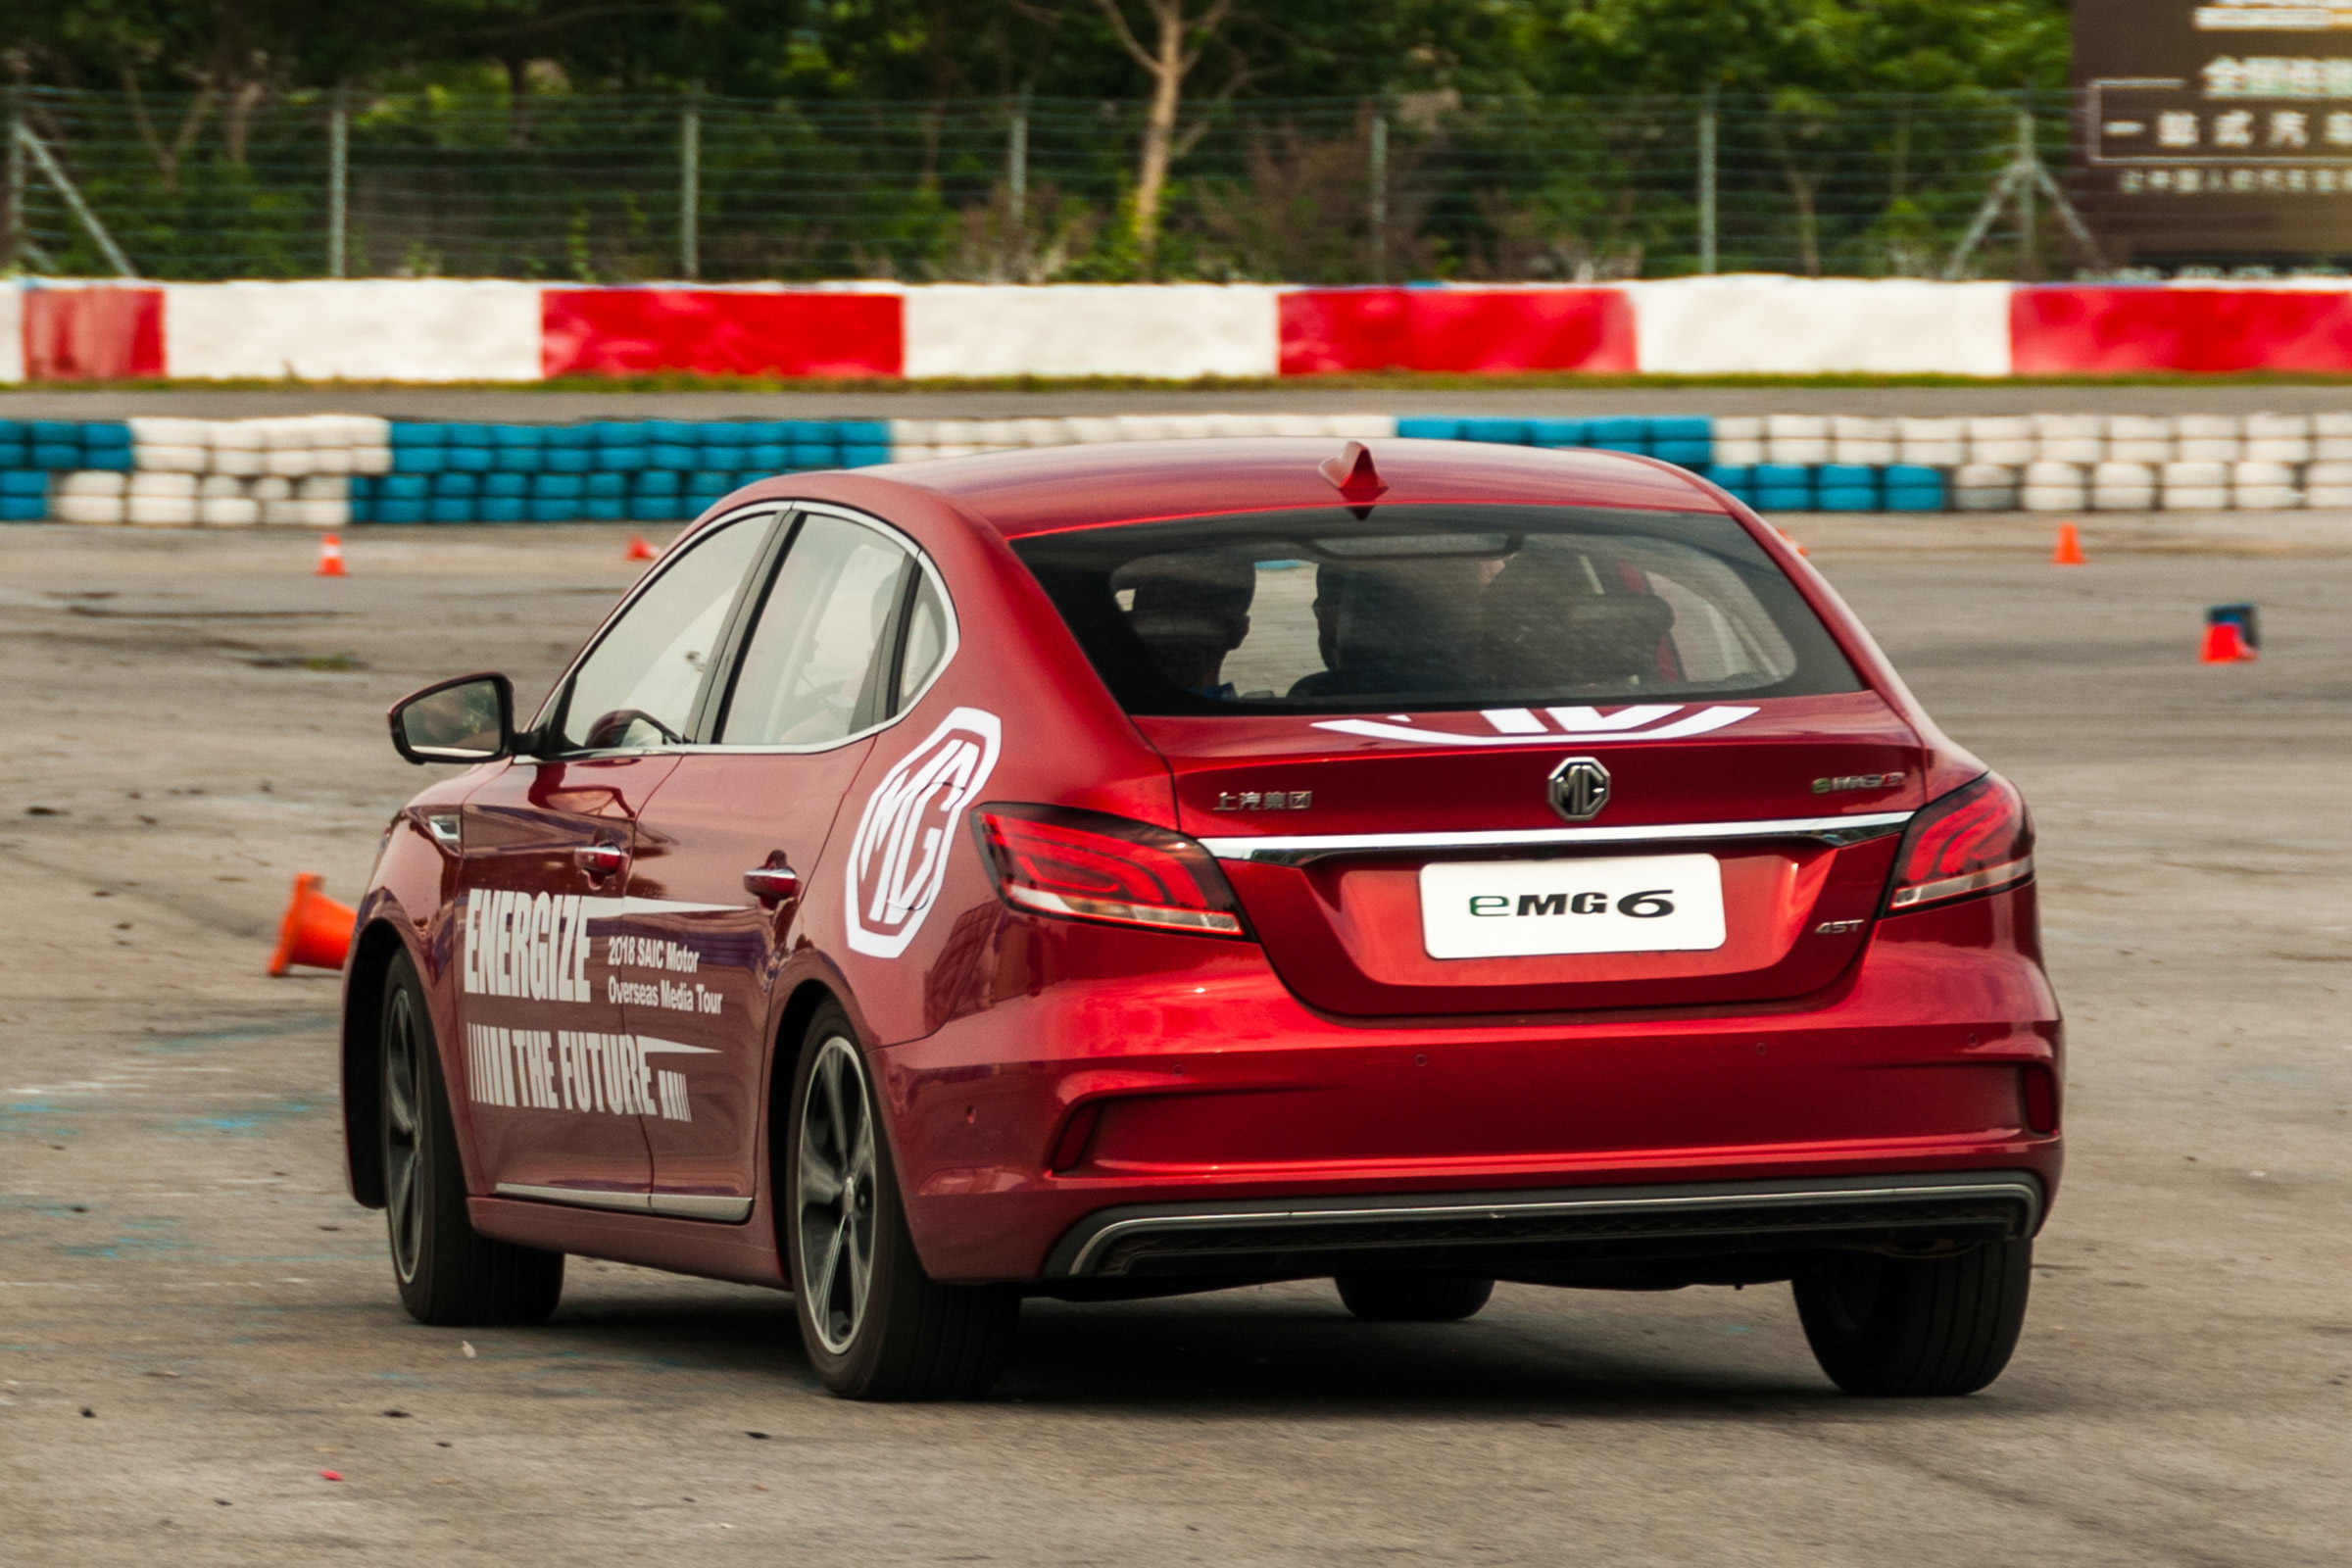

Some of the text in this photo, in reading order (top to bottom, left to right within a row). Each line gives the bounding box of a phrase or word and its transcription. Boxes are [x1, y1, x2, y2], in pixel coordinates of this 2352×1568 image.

[1212, 790, 1313, 811] 上汽集团
[1551, 763, 1607, 815] MG
[858, 737, 982, 926] MG
[464, 888, 592, 1003] ENERGIZE
[1815, 918, 1865, 934] 45T
[608, 936, 700, 973] 2018 SAIC Motor
[609, 975, 723, 1014] Overseas Media Tour
[512, 1029, 658, 1116] THE FUTURE
